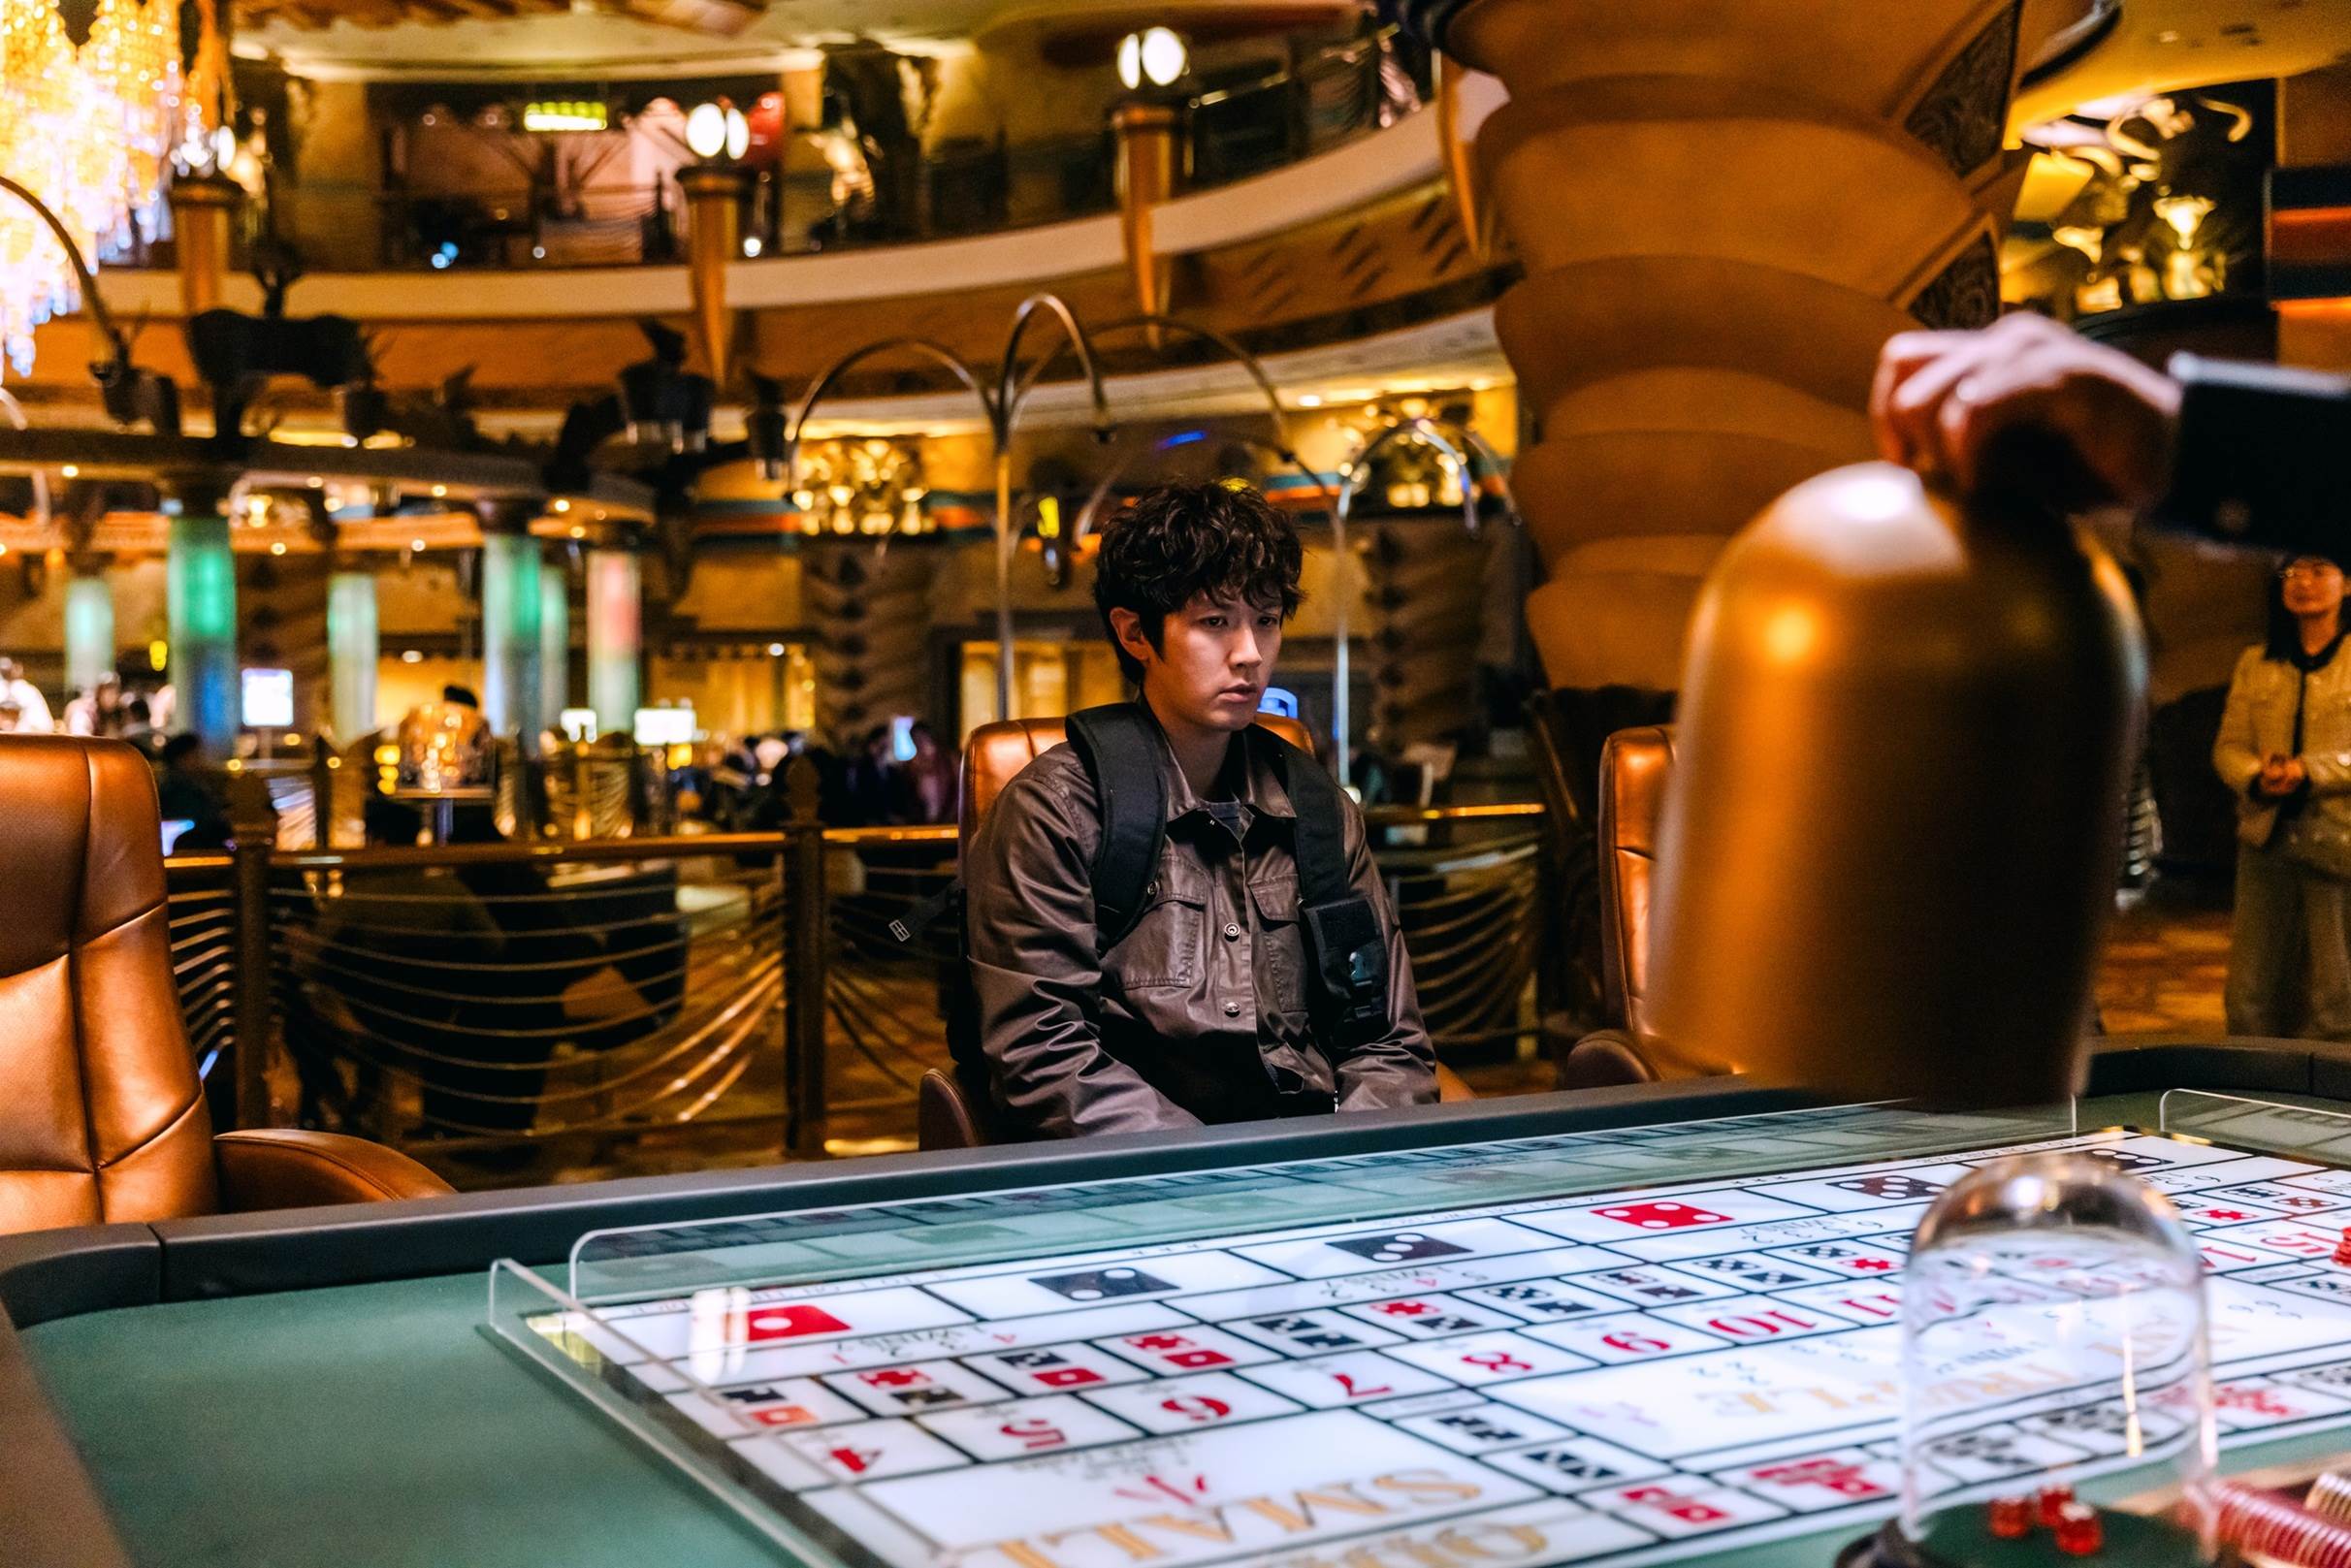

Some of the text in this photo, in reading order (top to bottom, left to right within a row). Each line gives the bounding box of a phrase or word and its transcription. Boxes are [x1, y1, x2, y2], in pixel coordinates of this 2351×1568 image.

[2260, 1232, 2338, 1255] 15
[1707, 1310, 1818, 1336] 10
[1601, 1331, 1671, 1353] 9
[1462, 1351, 1533, 1375] 8
[1332, 1371, 1393, 1398] 7
[1161, 1392, 1232, 1422] 6
[999, 1418, 1068, 1451] 5
[827, 1444, 883, 1475] 4
[1114, 1474, 1208, 1506] 小
[939, 1468, 1483, 1568] SMALL
